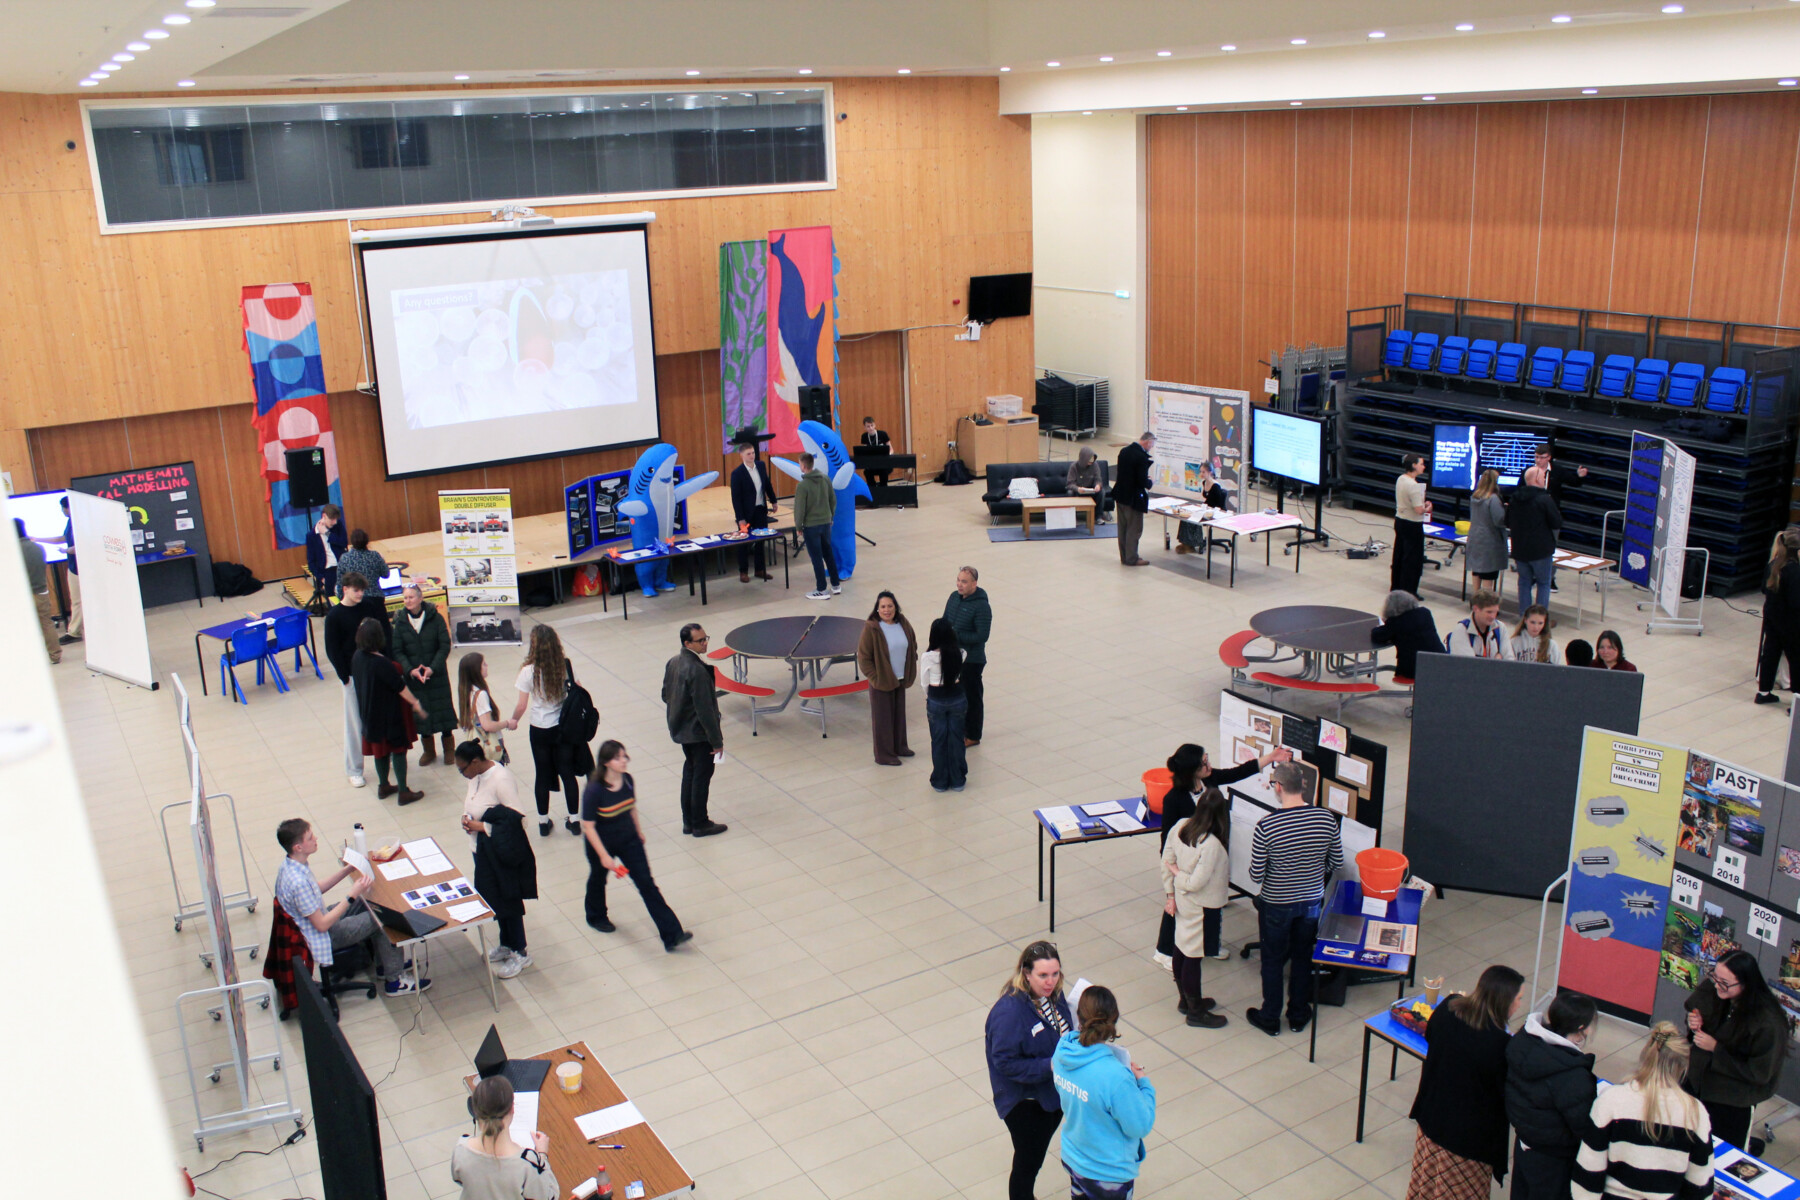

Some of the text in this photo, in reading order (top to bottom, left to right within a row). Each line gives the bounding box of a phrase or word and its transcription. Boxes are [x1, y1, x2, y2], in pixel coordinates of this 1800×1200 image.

[404, 291, 473, 308] Any questions?
[109, 467, 184, 488] MATHEMATI
[127, 477, 190, 493] MODELLING
[467, 495, 506, 503] CONTROVERSIAL
[1613, 743, 1662, 758] CORRUPTION
[1615, 765, 1657, 779] ORGANISED
[1613, 773, 1658, 788] DRUG CRIME
[1715, 767, 1758, 794] PAST
[1676, 874, 1699, 890] 2016
[1717, 867, 1740, 885] 2018
[1754, 907, 1778, 925] 2020
[1053, 1073, 1089, 1103] GUSTUS
